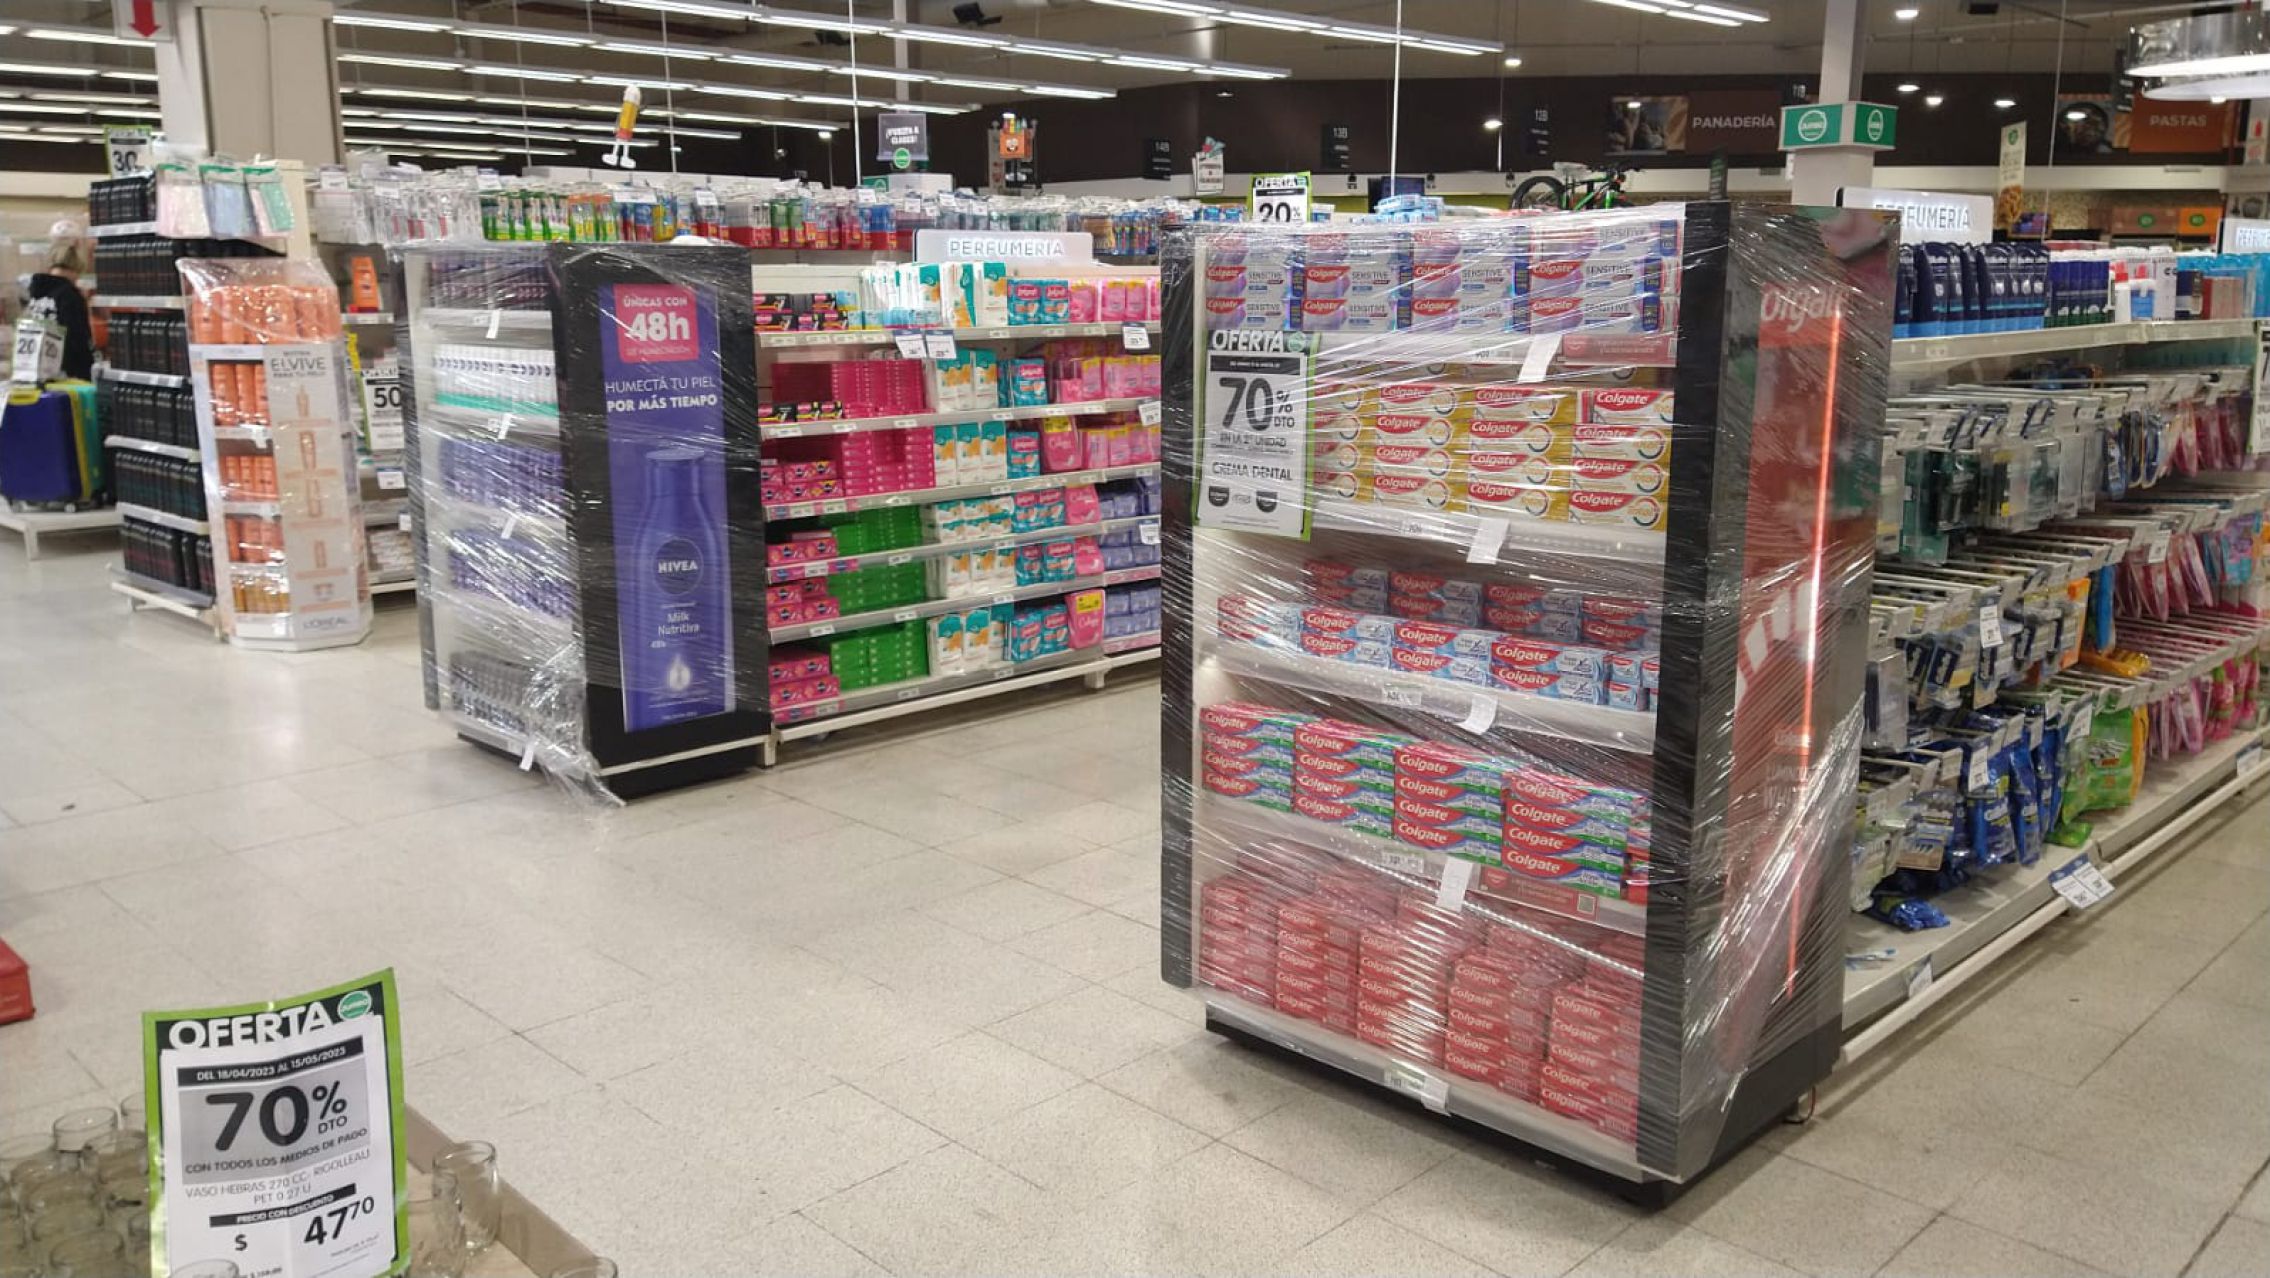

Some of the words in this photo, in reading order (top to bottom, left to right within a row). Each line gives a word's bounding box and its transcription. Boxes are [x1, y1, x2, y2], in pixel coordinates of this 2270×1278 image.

[1692, 113, 1776, 129] PANADERÍA
[2150, 115, 2208, 127] PASTAS
[1207, 267, 1241, 278] Colgate
[1307, 269, 1343, 279] Colgate
[1532, 264, 1574, 275] Colgate
[664, 296, 688, 307] CON
[1207, 301, 1239, 311] Colgate
[1304, 301, 1339, 311] Colgate
[1413, 301, 1451, 312] Colgate
[1532, 301, 1574, 311] Colgate
[628, 311, 691, 341] 48h
[1212, 330, 1284, 351] OFERTA
[271, 357, 327, 371] ELVIVE
[605, 376, 668, 393] HUMECTÁ
[670, 377, 688, 389] TU
[691, 376, 717, 388] PIEL
[1381, 387, 1426, 399] Colgate
[606, 399, 636, 412] POR
[639, 394, 667, 410] MÁS
[670, 393, 718, 408] TIEMPO
[1597, 391, 1649, 406] Colgate
[1274, 417, 1295, 429] DTO
[1376, 416, 1421, 429] Colgate
[1471, 421, 1518, 434] Colgate
[1575, 426, 1627, 440] Colgate
[1376, 446, 1420, 459] Colgate
[1471, 453, 1517, 467] Colgate
[1252, 465, 1294, 481] DENTAL
[1574, 459, 1626, 473] Colgate
[1375, 475, 1419, 489] Colgate
[1469, 483, 1516, 497] Colgate
[1571, 490, 1624, 507] Colgate
[658, 560, 698, 574] NIVEA
[1393, 576, 1440, 590] Colgate
[1488, 585, 1536, 601] Colgate
[1306, 613, 1351, 629] Colgate
[1400, 629, 1446, 644] Colgate
[1587, 623, 1637, 639] Colgate
[1304, 636, 1349, 651] Colgate
[1396, 651, 1444, 667] Colgate
[1496, 645, 1548, 662] Colgate
[1498, 669, 1550, 686] Colgate
[1205, 711, 1247, 729] Colgate
[1206, 733, 1248, 750] Colgate
[1299, 732, 1344, 749] Colgate
[1205, 752, 1248, 770] Colgate
[1300, 754, 1345, 772] Colgate
[1400, 754, 1448, 774] Colgate
[1205, 774, 1246, 792] Colgate
[1298, 775, 1344, 794] Colgate
[1400, 777, 1448, 798] Colgate
[1298, 797, 1342, 817] Colgate
[1400, 800, 1448, 821] Colgate
[1511, 803, 1566, 826] Colgate
[1398, 822, 1447, 844] Colgate
[1509, 827, 1563, 849] Colgate
[1507, 850, 1560, 874] Colgate
[1456, 963, 1501, 985] Colgate
[1450, 986, 1494, 1007] Colgate
[1555, 995, 1602, 1018] Colgate
[168, 1001, 334, 1050] OFERTA
[1450, 1009, 1494, 1029] Colgate
[1552, 1019, 1600, 1042] Colgate
[197, 1071, 215, 1081] DEL
[217, 1066, 275, 1080] 18/04/2023
[277, 1062, 290, 1073] AL
[291, 1046, 346, 1069] 15/05/2023
[1447, 1053, 1489, 1075] Colgate
[1552, 1044, 1598, 1067] Colgate
[1542, 1066, 1590, 1089] Colgate
[1542, 1089, 1588, 1112] Colgate
[318, 1115, 348, 1135] DTO
[186, 1163, 212, 1175] CON
[215, 1158, 254, 1170] TODOS
[256, 1156, 278, 1168] LOS
[280, 1145, 321, 1165] MEDIOS
[322, 1140, 335, 1151] DE
[338, 1128, 368, 1144] PAGO
[186, 1184, 218, 1198] VASO
[221, 1180, 267, 1196] HEBRAS
[269, 1176, 290, 1191] 270
[314, 1149, 371, 1177] RIGOLLEAU
[254, 1191, 273, 1204] PET
[302, 1184, 312, 1196] U
[237, 1212, 267, 1224] PRECIO
[269, 1207, 288, 1219] CON
[235, 1234, 248, 1251] $
